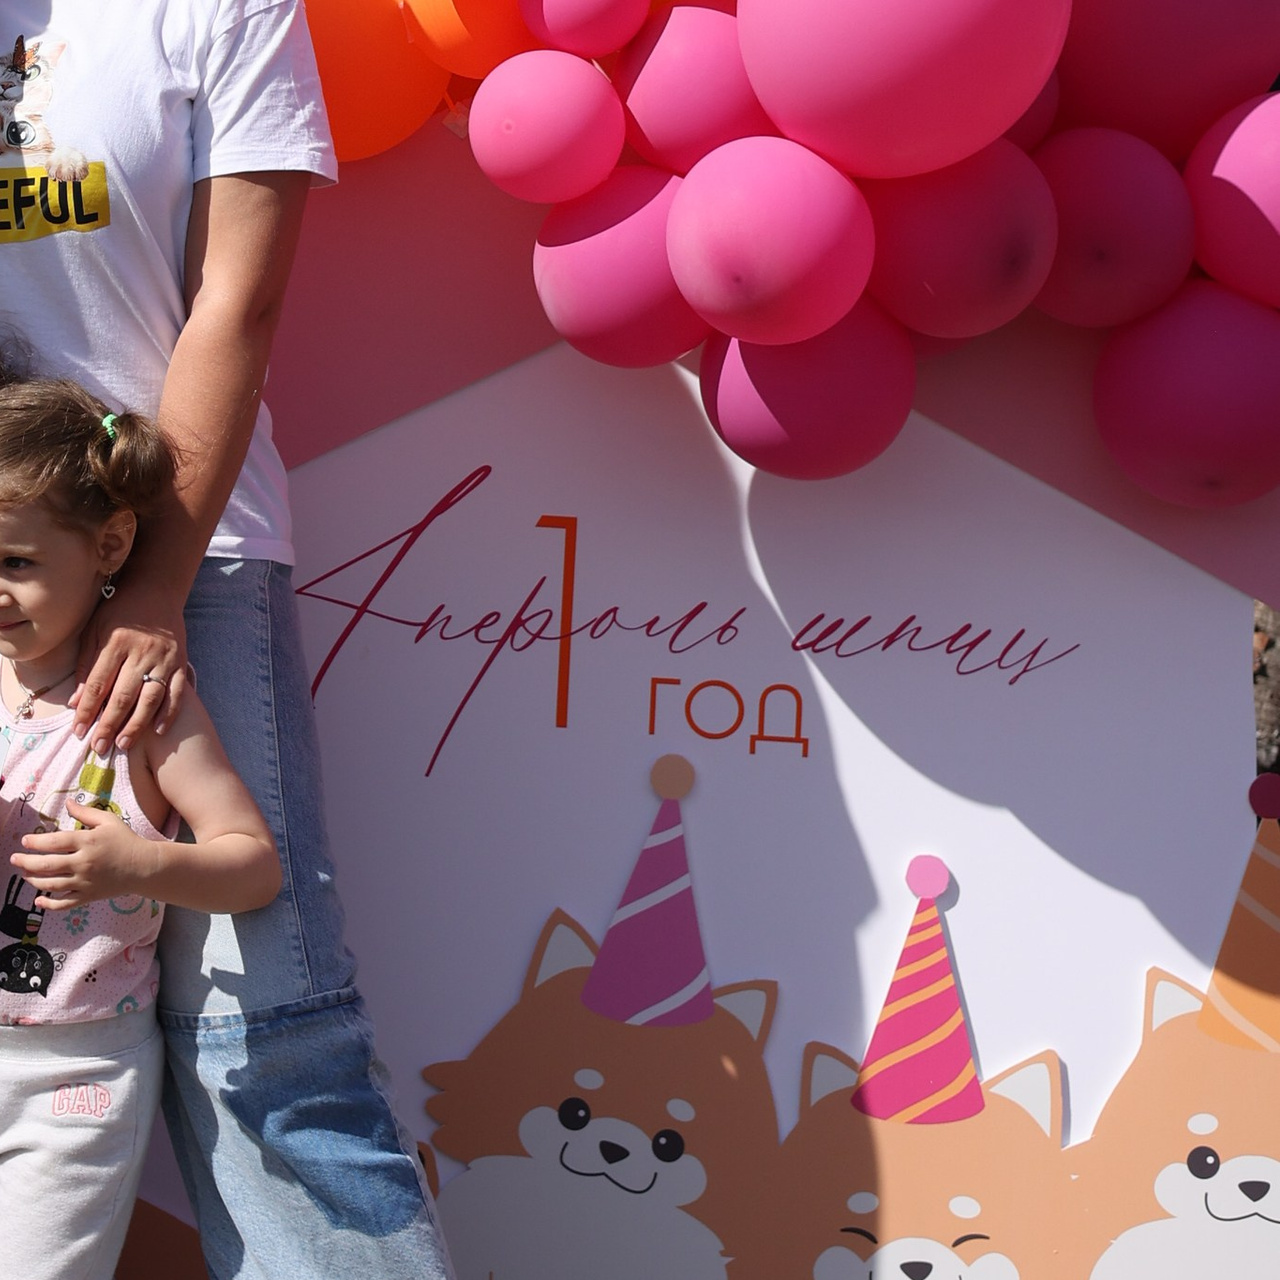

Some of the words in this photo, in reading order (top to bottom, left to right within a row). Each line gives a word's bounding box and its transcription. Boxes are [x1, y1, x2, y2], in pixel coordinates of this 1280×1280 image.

[294, 465, 748, 779] Апероль
[535, 515, 578, 729] 1
[648, 677, 810, 759] ГОД
[51, 1083, 111, 1118] GAP
